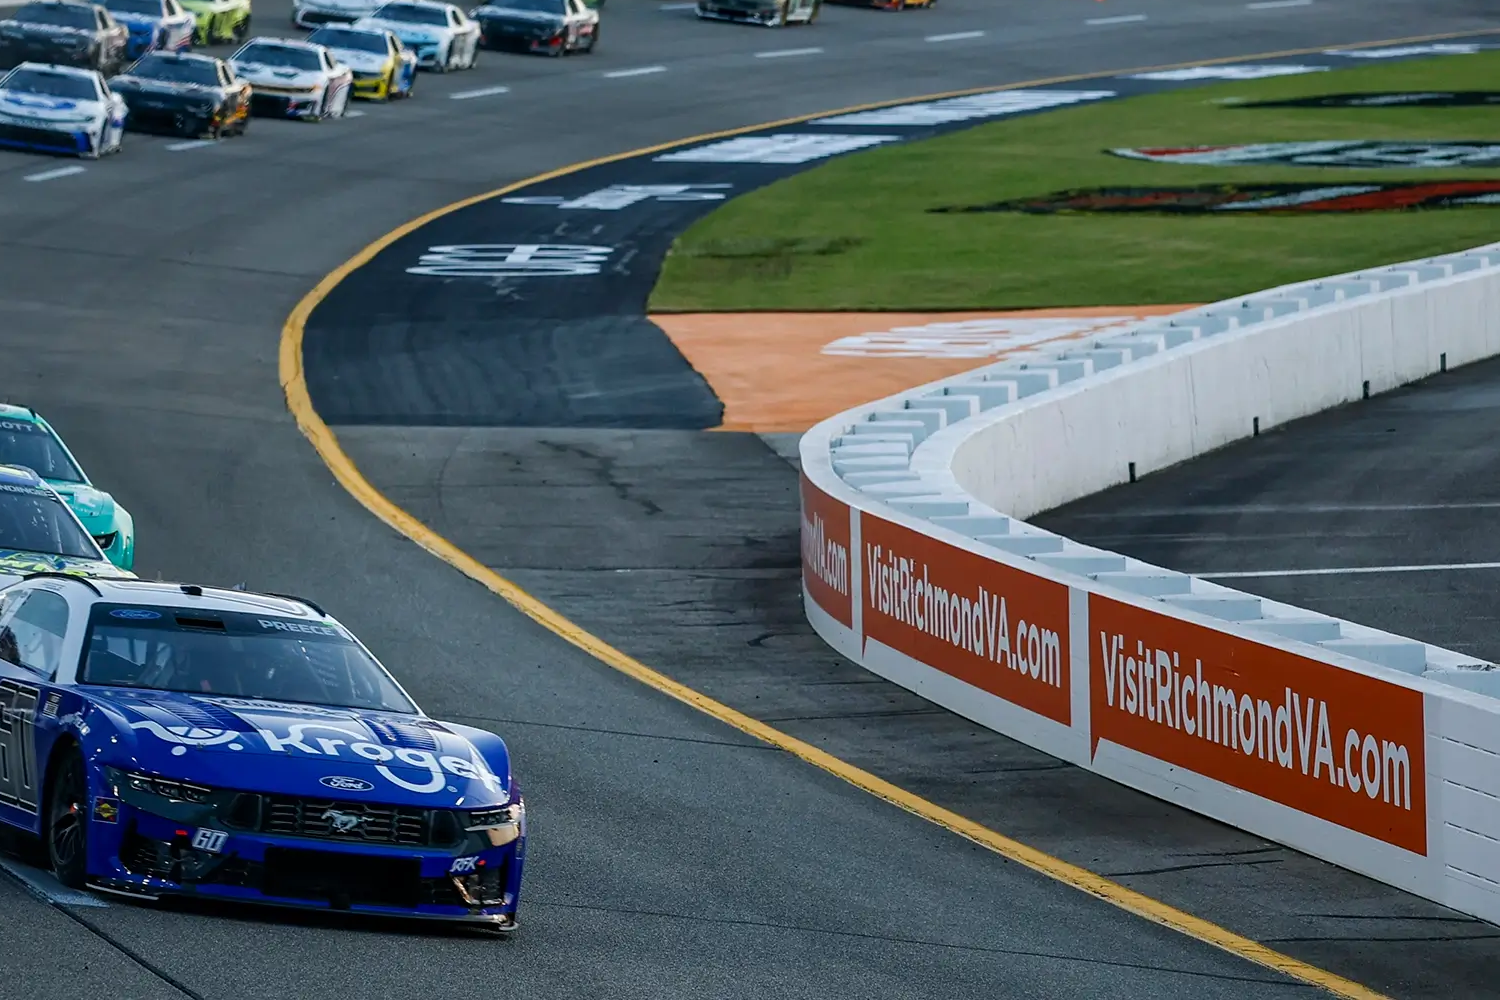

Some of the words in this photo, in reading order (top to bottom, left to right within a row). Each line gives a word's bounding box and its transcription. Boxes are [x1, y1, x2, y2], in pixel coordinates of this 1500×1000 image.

[257, 619, 336, 637] PREECE
[866, 543, 1061, 689] VisitRichmondVA.com
[1099, 630, 1412, 811] VisitRichmondVA.com
[259, 723, 503, 794] Kroger
[192, 827, 229, 852] 60
